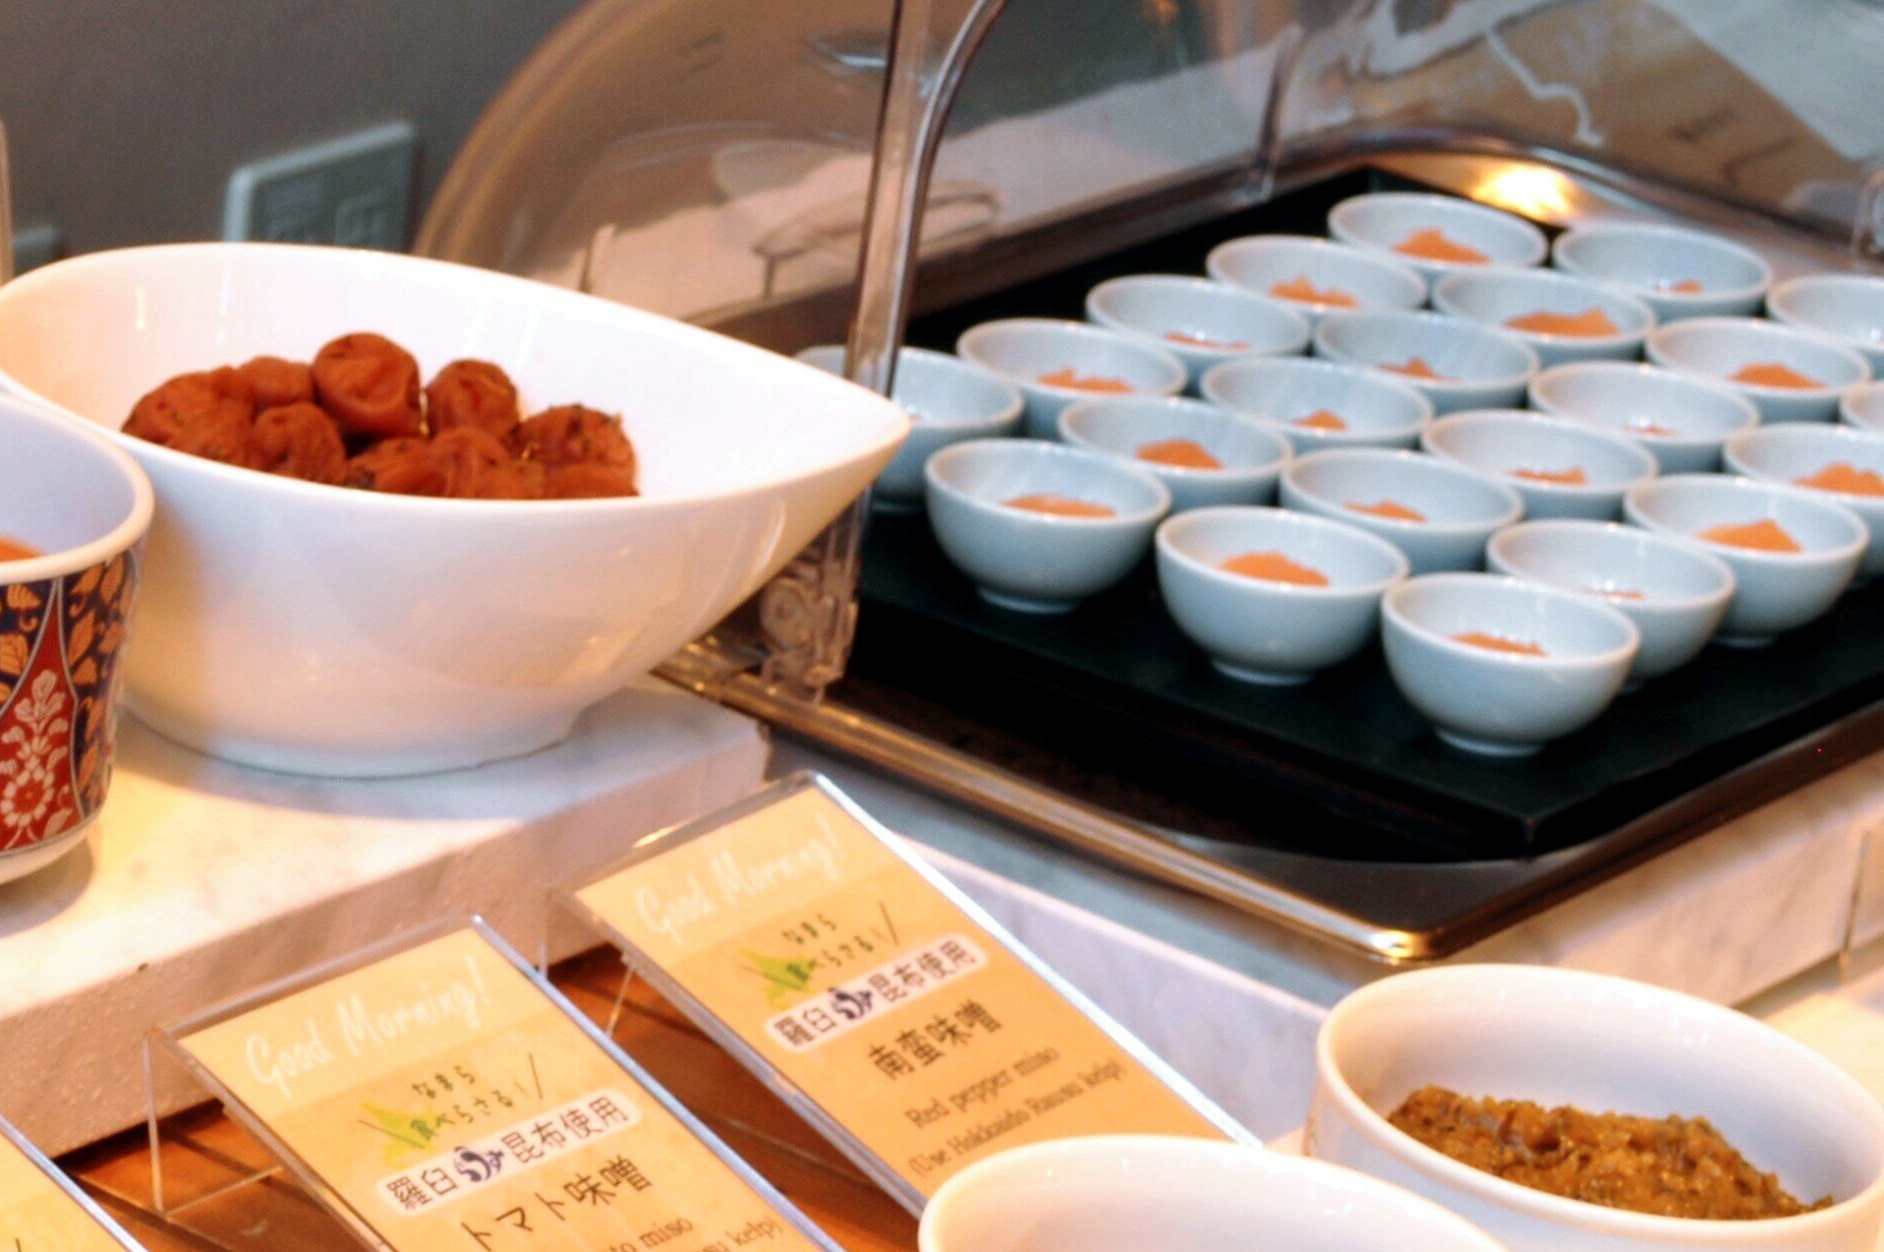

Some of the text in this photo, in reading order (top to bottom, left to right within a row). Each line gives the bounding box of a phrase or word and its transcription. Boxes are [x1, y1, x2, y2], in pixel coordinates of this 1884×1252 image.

[635, 869, 702, 945] Good
[246, 956, 493, 1097] Good Morning!
[905, 1046, 1060, 1128] Red pepper miso
[459, 1153, 651, 1252] トマト味噌
[639, 1216, 694, 1249] miso
[726, 1217, 785, 1248] kelp)
